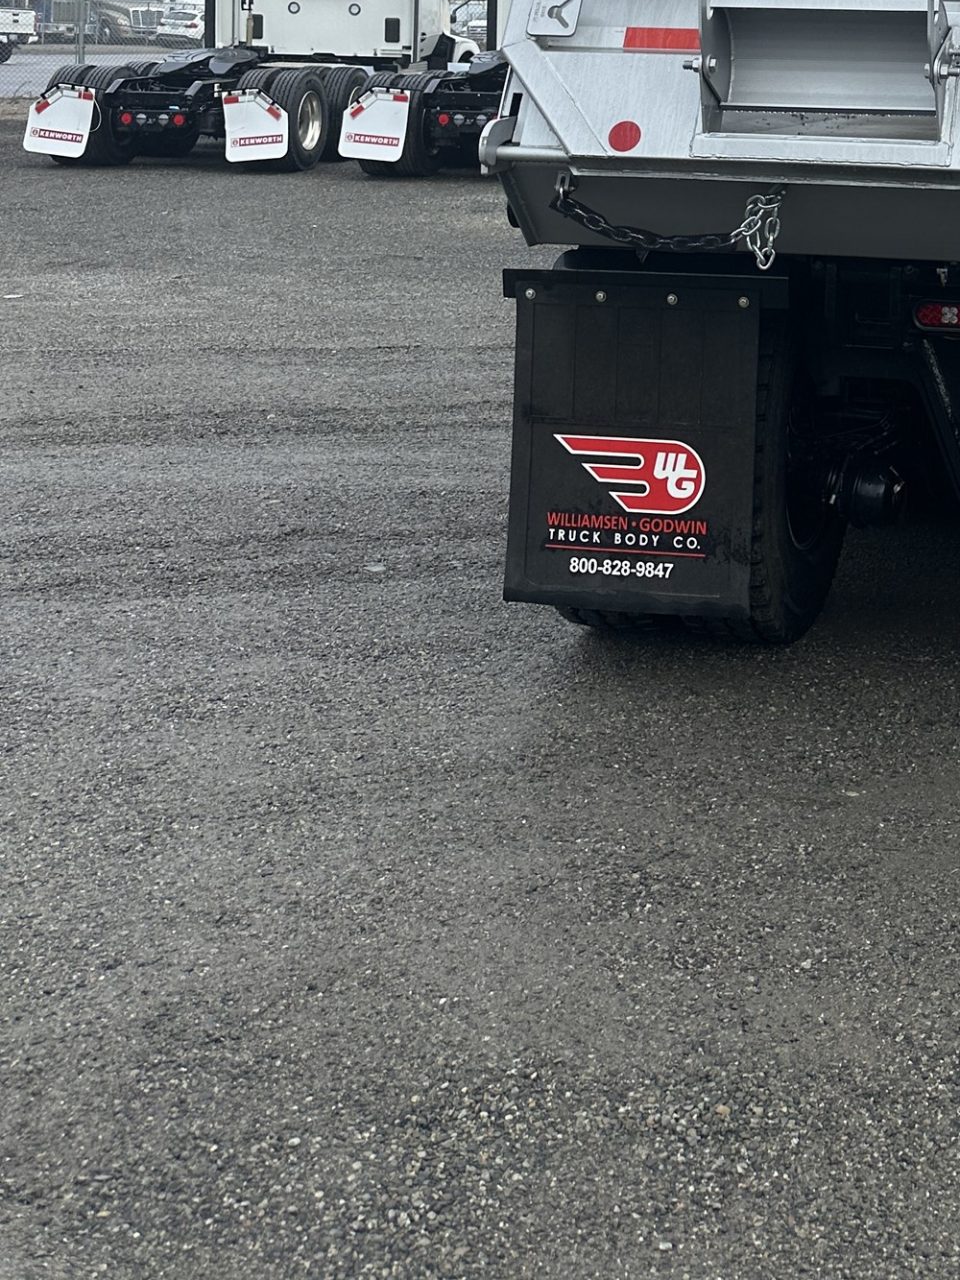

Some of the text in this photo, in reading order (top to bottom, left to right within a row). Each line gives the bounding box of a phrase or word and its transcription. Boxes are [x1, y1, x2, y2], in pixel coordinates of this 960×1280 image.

[39, 130, 83, 142] KENWORTH
[240, 136, 282, 145] KENWORTH
[354, 134, 399, 145] KENWORTH
[547, 511, 707, 535] WILLIAMSEN GODWIN
[549, 528, 701, 549] TRUCK BODY CO.
[569, 556, 674, 579] 800-828-9847
